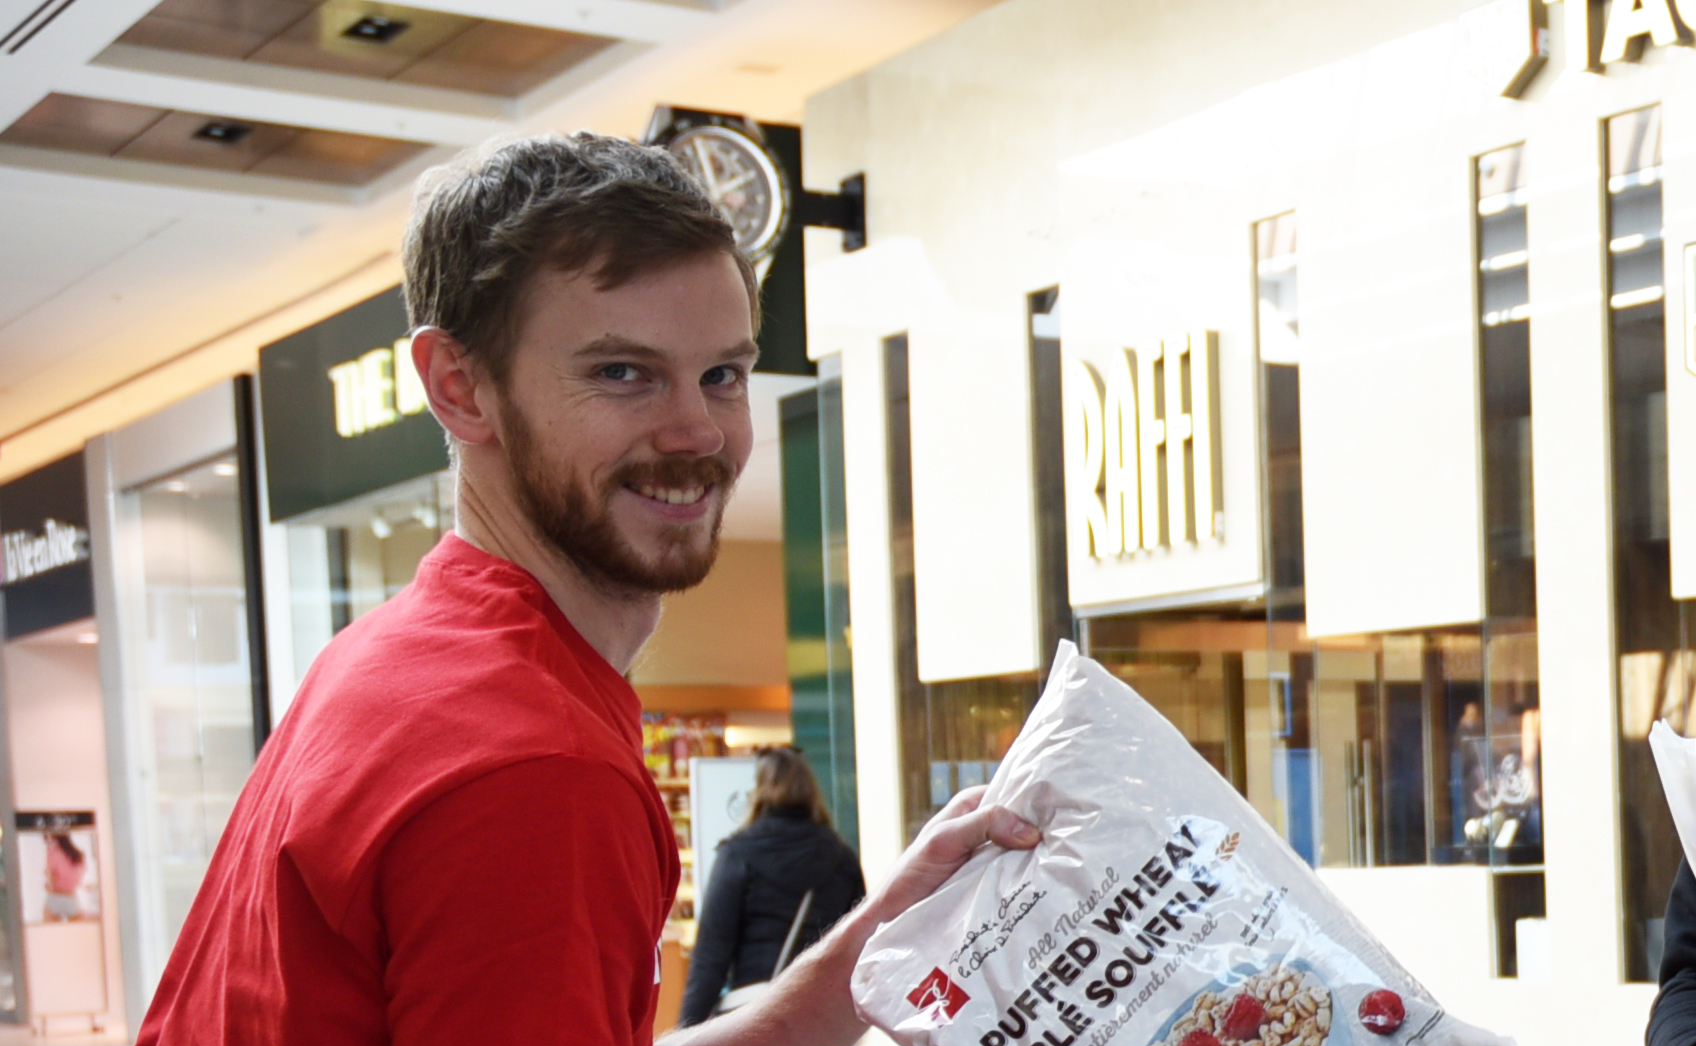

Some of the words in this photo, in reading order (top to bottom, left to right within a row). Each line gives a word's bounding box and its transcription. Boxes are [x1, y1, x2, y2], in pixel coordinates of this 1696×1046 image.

[328, 348, 396, 438] THE
[1027, 932, 1057, 970] All
[1054, 866, 1121, 937] Natural
[1084, 865, 1221, 1009] SOUFFLÉ
[1162, 911, 1219, 982] naturel
